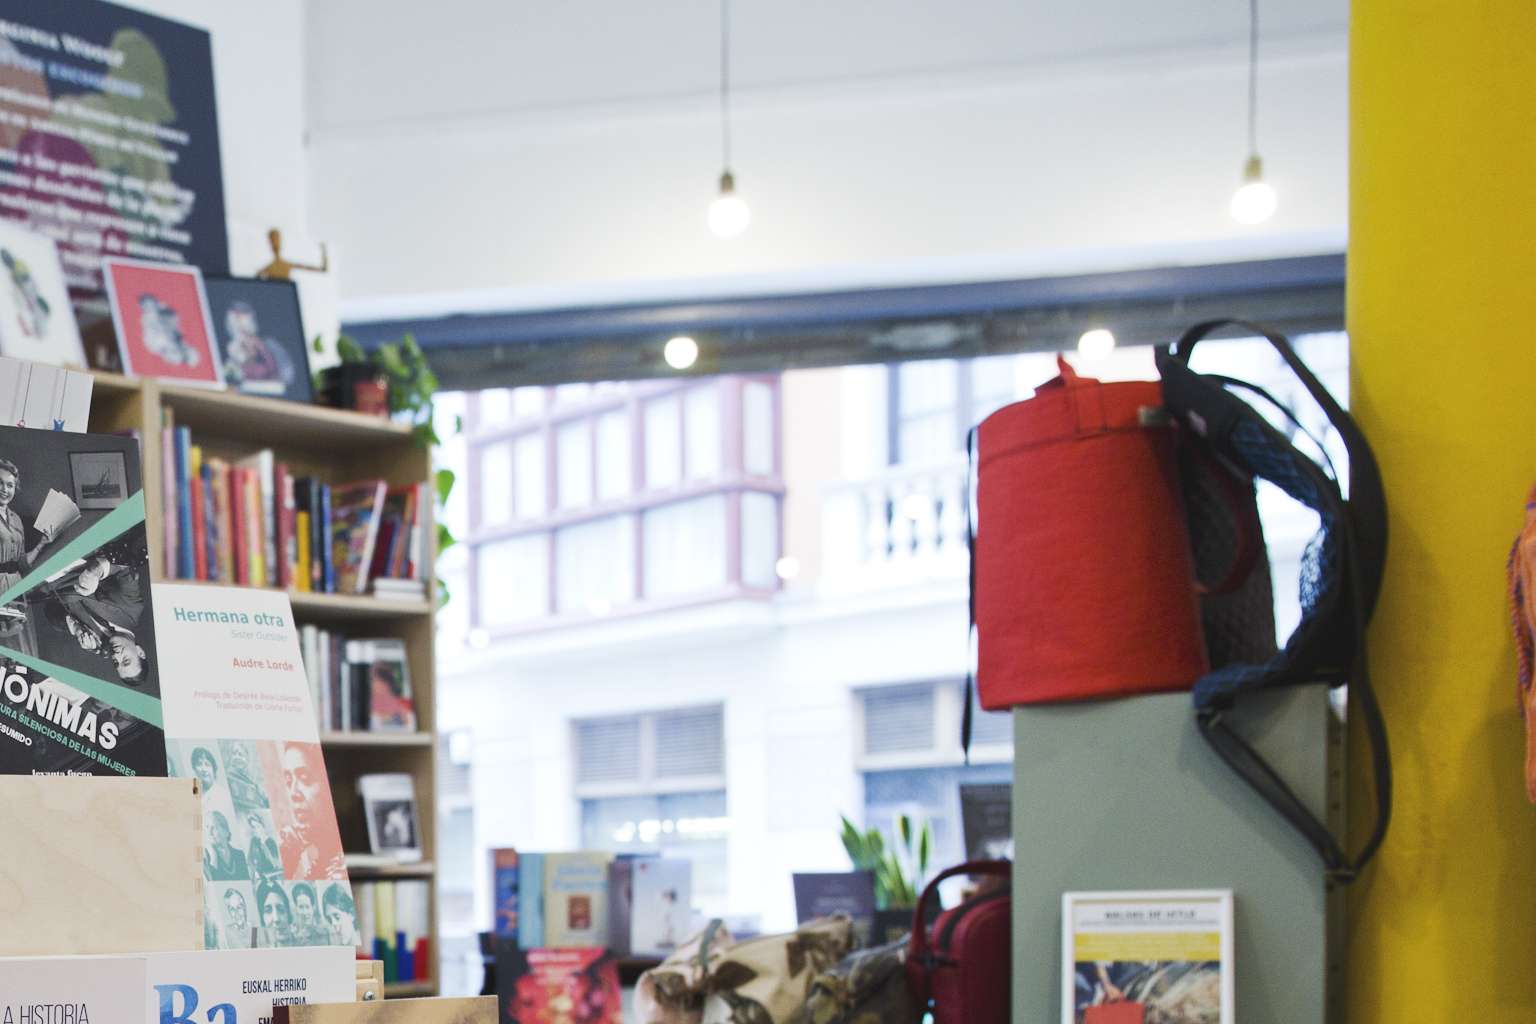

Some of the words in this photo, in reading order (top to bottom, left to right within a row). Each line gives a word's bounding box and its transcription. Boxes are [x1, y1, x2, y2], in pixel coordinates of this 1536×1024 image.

[174, 607, 249, 625] Hermana
[253, 613, 285, 628] otra
[233, 657, 265, 669] Audre
[267, 659, 294, 672] Lorde
[18, 713, 69, 746] SILENCIOSA
[68, 740, 81, 752] DE
[80, 744, 98, 760] LAS
[97, 753, 137, 776] MUJERES
[242, 980, 273, 994] EUSKAL
[274, 978, 307, 993] HERRIKO
